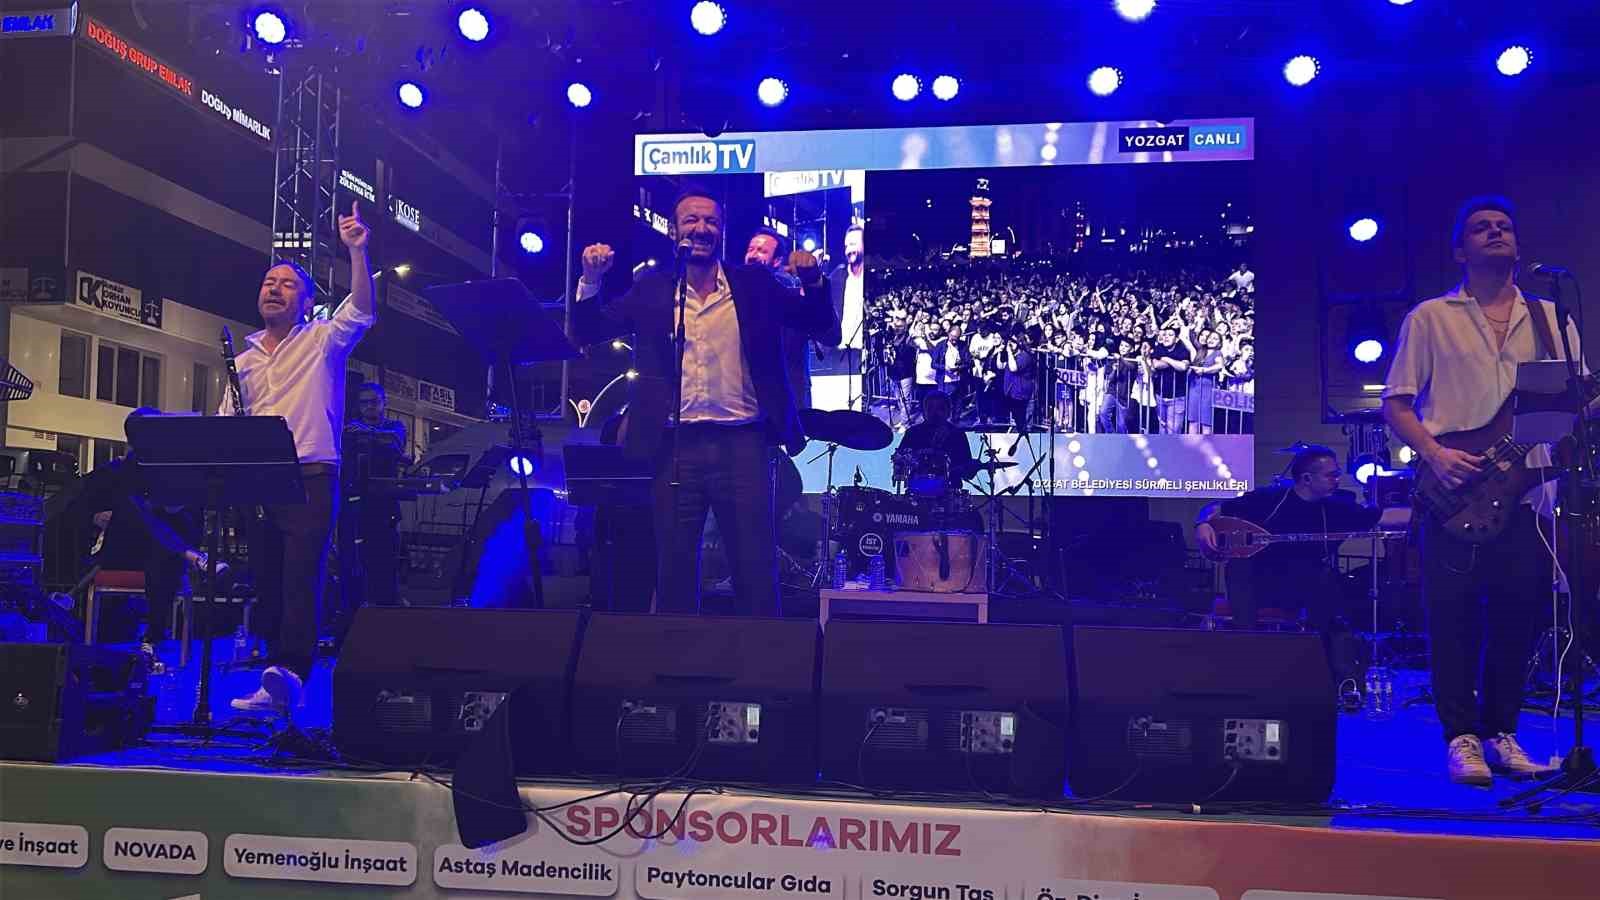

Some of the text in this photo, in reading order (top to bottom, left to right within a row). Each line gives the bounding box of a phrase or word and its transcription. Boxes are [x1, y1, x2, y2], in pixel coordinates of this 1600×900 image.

[87, 20, 193, 96] DOĞUŞ GRUP EMLAK
[201, 89, 271, 141] DOĞUŞ MİMARLIK
[1124, 132, 1240, 147] YOZGAT CANLI
[648, 143, 754, 170] Çamlık TV
[103, 289, 131, 304] ORHAN
[1071, 478, 1132, 489] BELEDİYESİ
[1135, 478, 1181, 490] SÜRMELİ
[1184, 479, 1248, 493] ŞENLİKLERİ
[886, 513, 919, 525] YAMAHA
[566, 804, 962, 857] SPONSORLARIMIZ
[19, 832, 79, 855] İnşaat
[114, 841, 196, 861] NOVADA
[234, 848, 408, 874] Yemenoğlu İnşaat
[438, 856, 612, 881] Astaş Madencilik
[647, 867, 831, 894] Paytoncular Gıda
[872, 880, 951, 900] Sorgun
